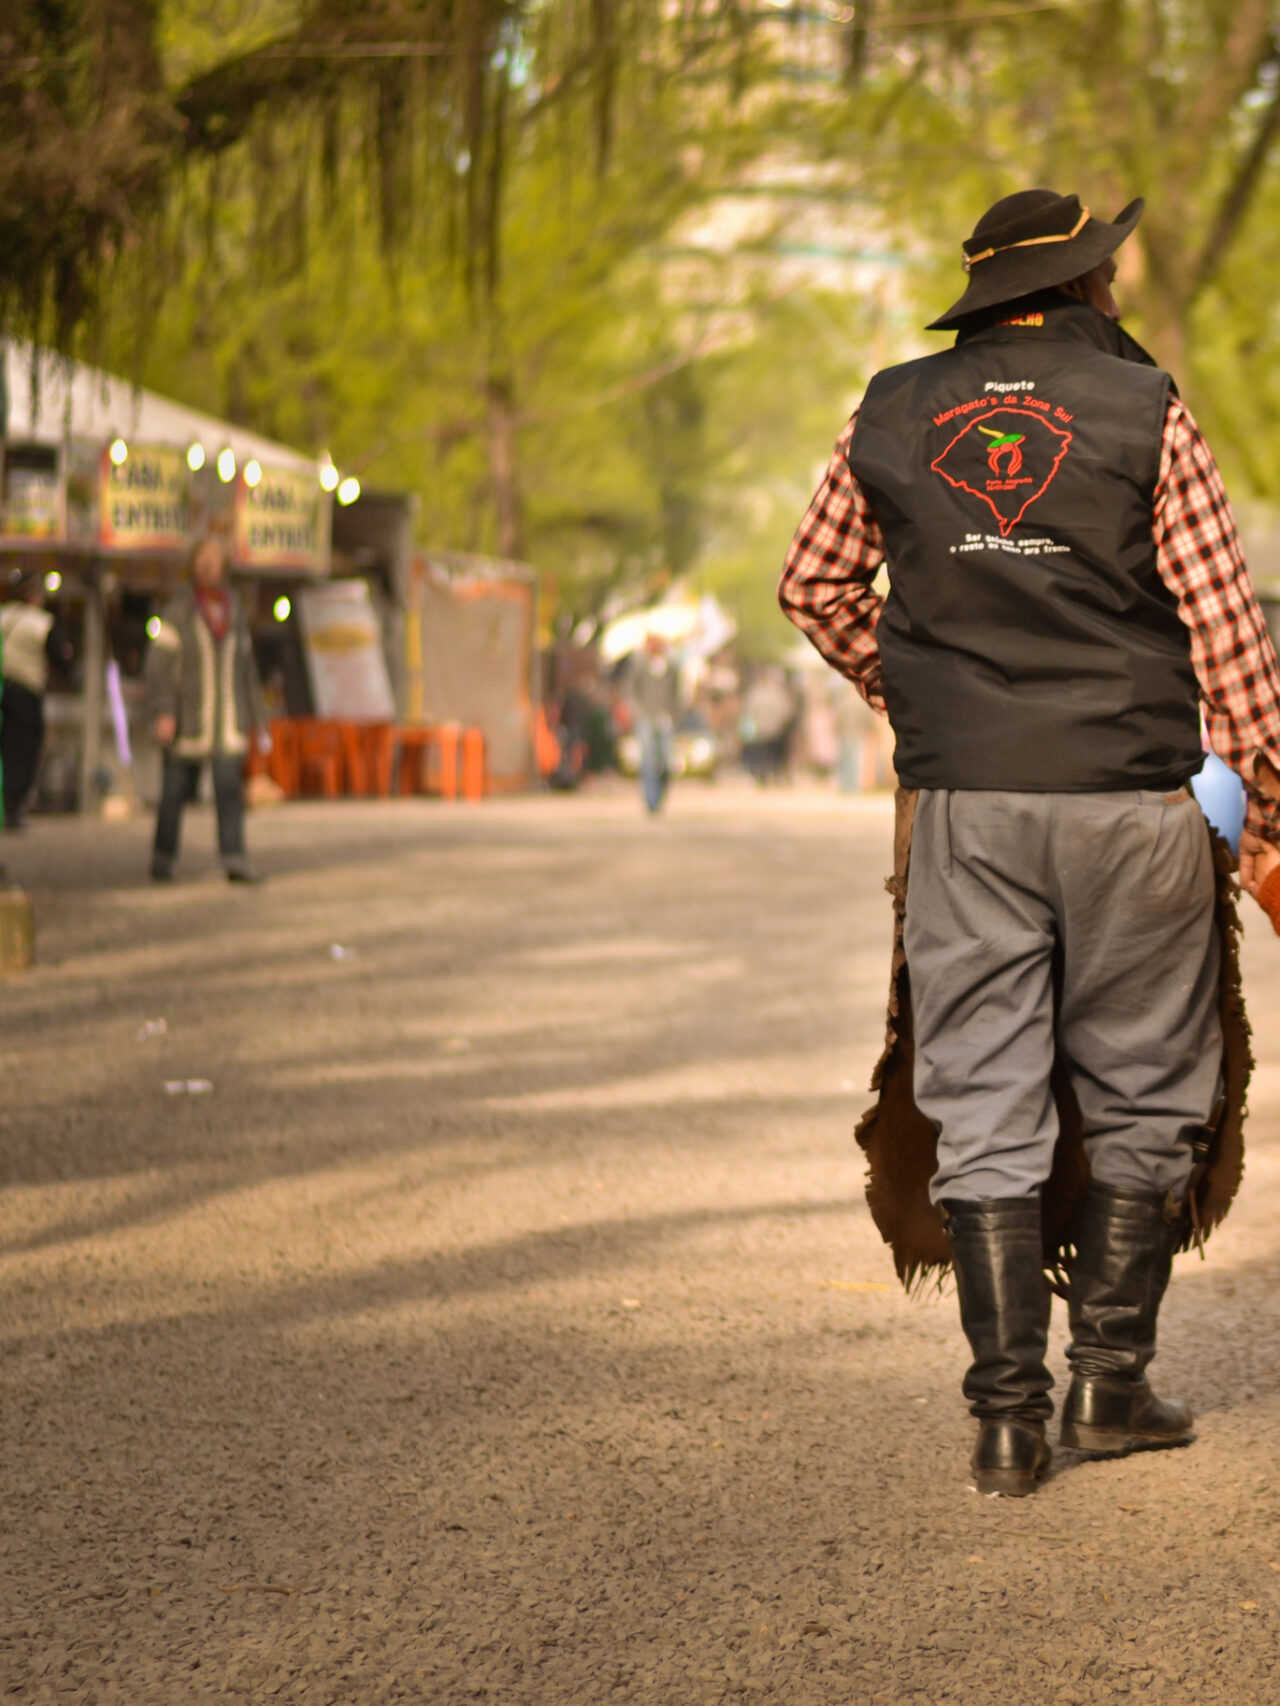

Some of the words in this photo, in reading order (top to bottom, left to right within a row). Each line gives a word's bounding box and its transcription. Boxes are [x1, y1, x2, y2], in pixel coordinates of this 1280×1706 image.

[984, 380, 1035, 393] Piquete
[1022, 395, 1051, 412] Zona
[1053, 406, 1075, 424] Sul
